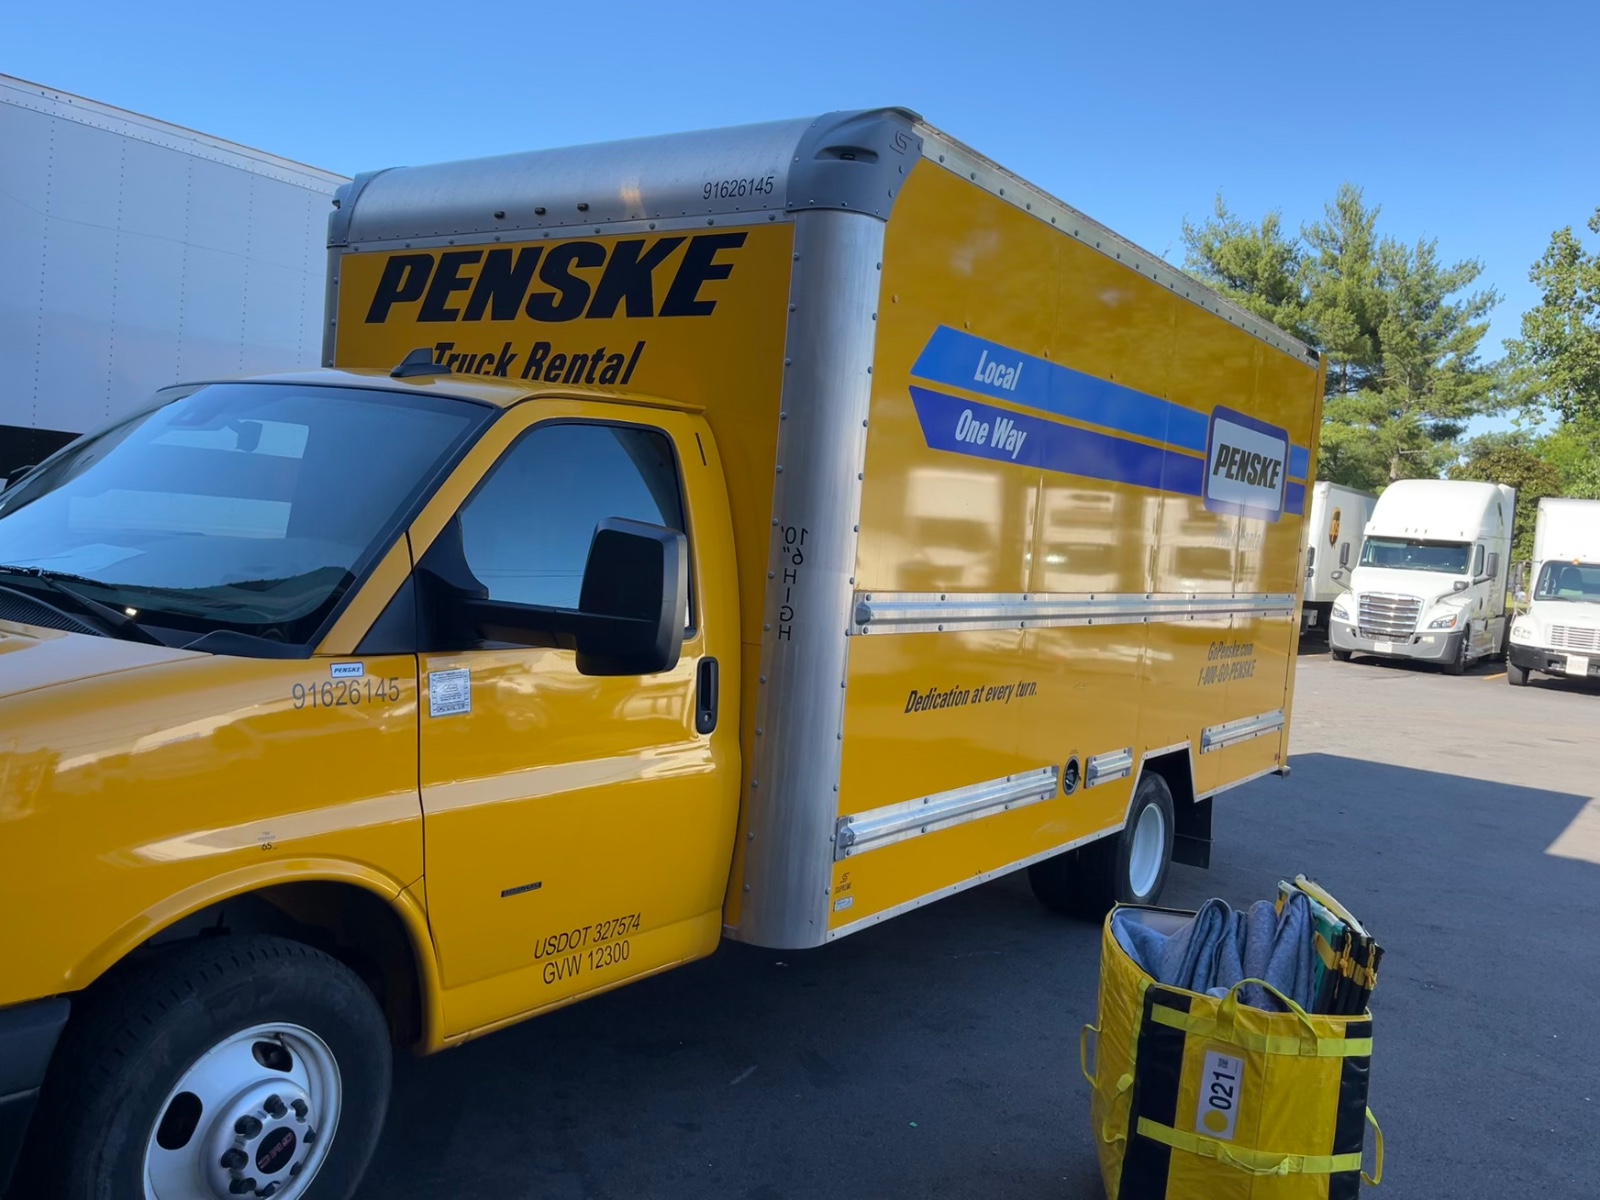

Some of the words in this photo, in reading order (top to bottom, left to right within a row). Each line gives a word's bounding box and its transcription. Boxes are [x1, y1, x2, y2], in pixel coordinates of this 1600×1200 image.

[703, 176, 774, 200] 91626145
[365, 232, 748, 323] PENSKE
[434, 342, 518, 377] Truck
[520, 341, 646, 385] Rental
[973, 349, 1023, 391] Local
[955, 409, 989, 445] One
[990, 416, 1027, 460] Way
[1213, 443, 1281, 489] PENSKE
[333, 666, 362, 674] PENSKE
[292, 677, 400, 710] 91626145
[904, 685, 971, 714] Dedication
[971, 685, 986, 704] at
[985, 684, 1015, 704] every
[1015, 680, 1038, 698] turn.
[534, 926, 592, 959] USDOT
[593, 913, 641, 943] 327574
[543, 953, 582, 985] GVW
[588, 940, 630, 971] 12300
[1208, 1070, 1235, 1110] 021
